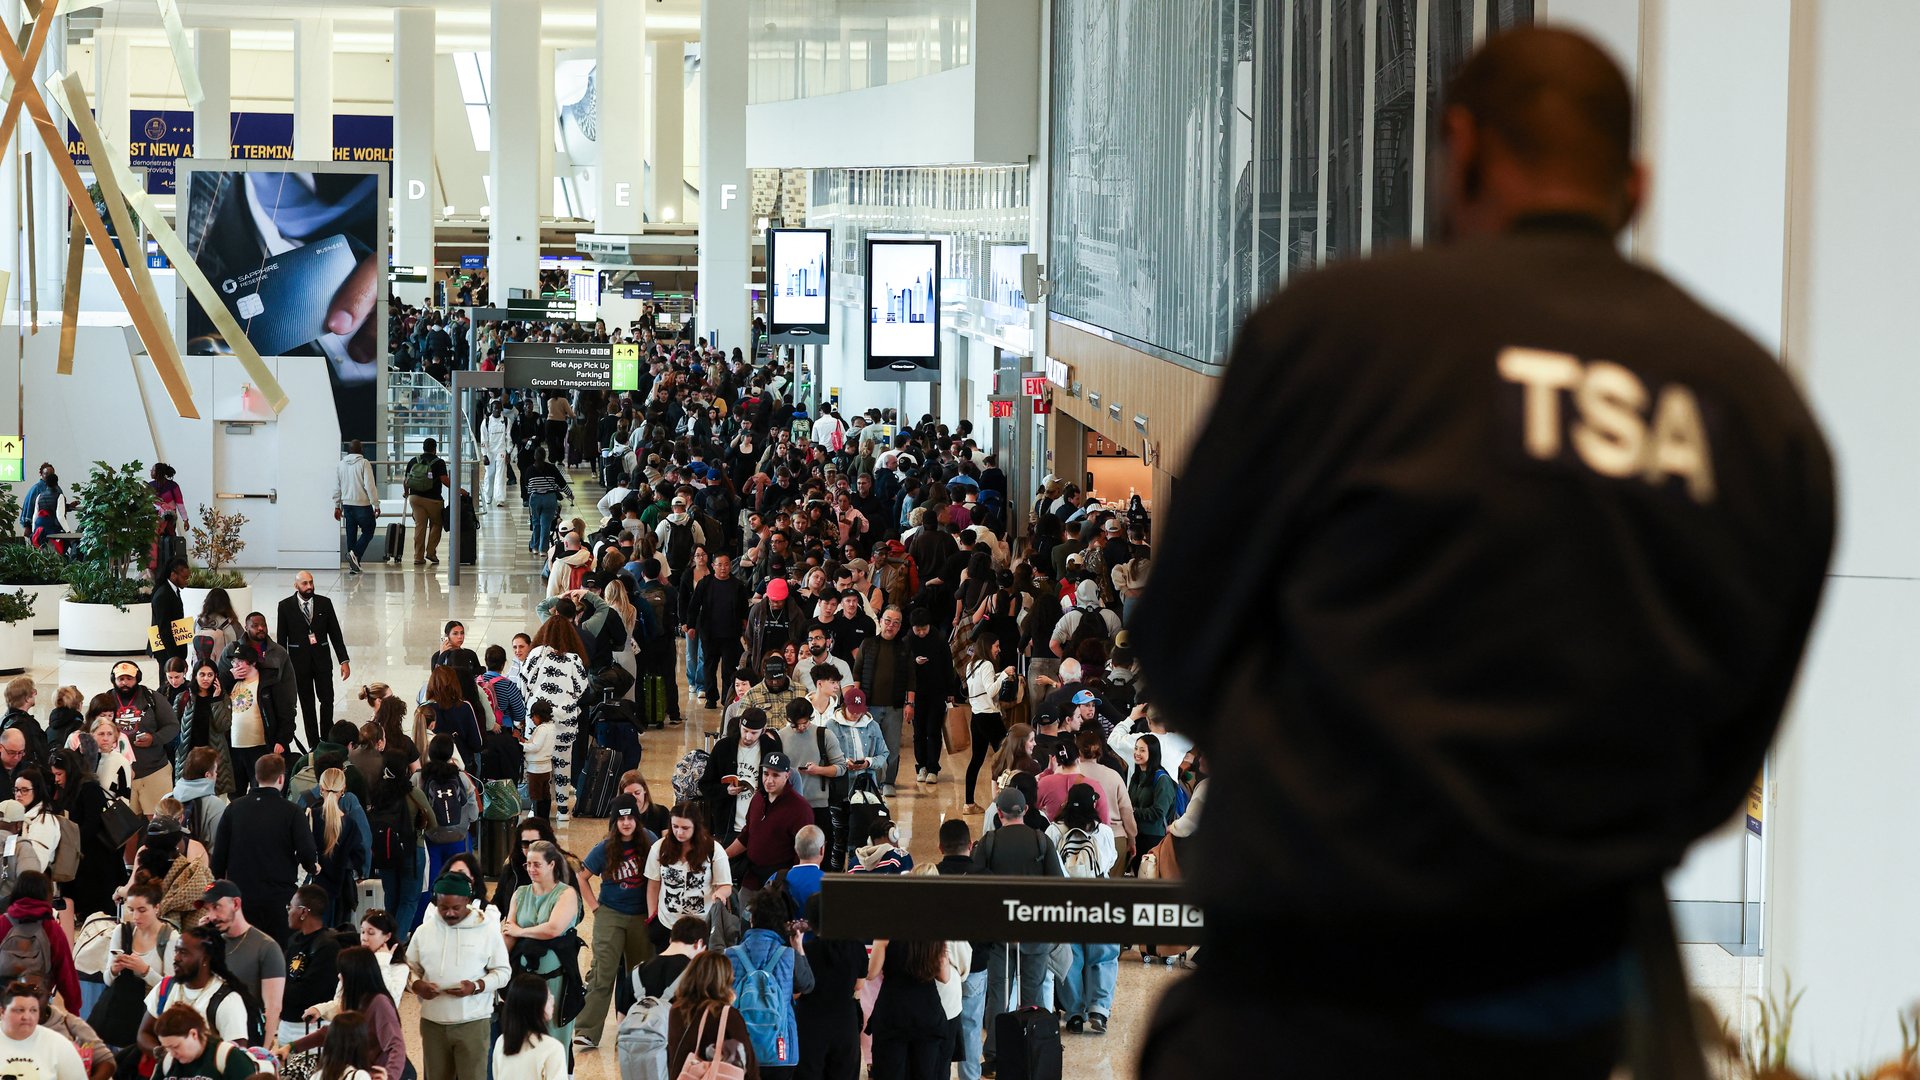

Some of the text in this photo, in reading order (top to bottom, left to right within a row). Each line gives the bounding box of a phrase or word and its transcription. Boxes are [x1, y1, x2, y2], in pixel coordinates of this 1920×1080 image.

[150, 143, 180, 157] NEW
[132, 159, 172, 167] demonstrate
[408, 179, 426, 200] D
[615, 182, 630, 207] E
[721, 184, 737, 210] F
[237, 262, 280, 283] SAPPHIRE
[546, 311, 568, 320] Parking
[554, 347, 589, 355] Terminals
[568, 362, 583, 370] App
[601, 362, 610, 370] Up
[576, 371, 602, 379] Parking
[992, 401, 1013, 417] EXIT
[1496, 345, 1719, 502] TSA
[768, 754, 780, 765] NY
[1003, 900, 1126, 924] Terminals
[1136, 906, 1152, 924] A
[1161, 907, 1176, 924] B
